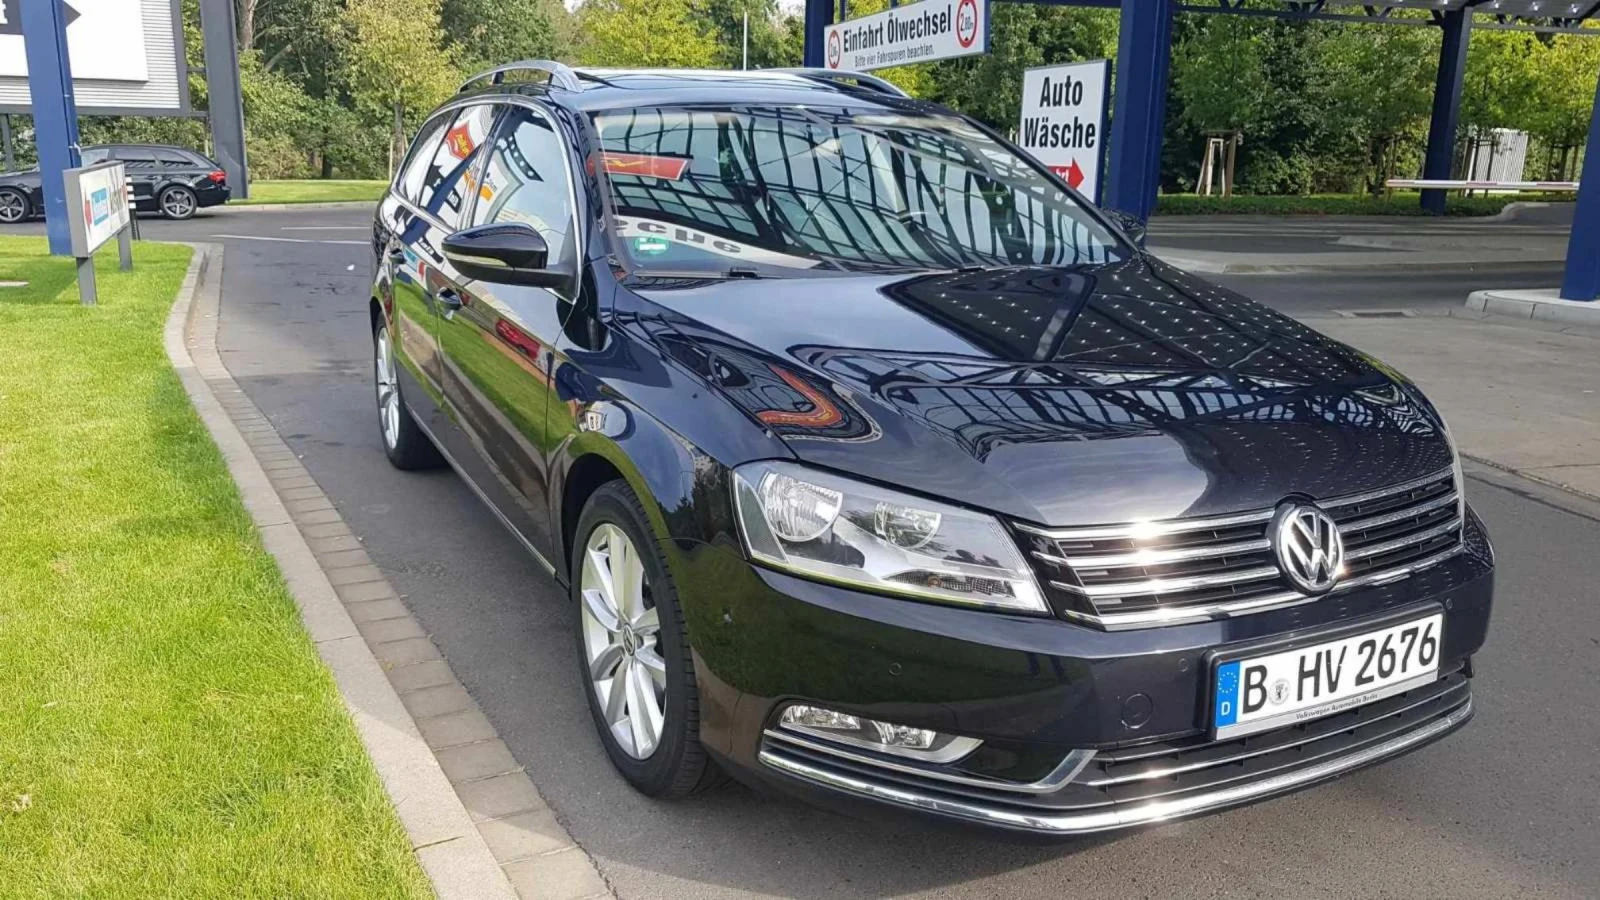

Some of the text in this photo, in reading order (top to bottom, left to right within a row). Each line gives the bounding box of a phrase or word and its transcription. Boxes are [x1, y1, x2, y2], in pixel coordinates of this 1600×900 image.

[843, 3, 952, 53] Einfahrt Ölwechsel
[855, 55, 866, 67] Bitte
[1039, 75, 1083, 108] Auto
[1024, 116, 1096, 148] Wäsche
[1276, 505, 1343, 592] VW
[1242, 622, 1436, 715] B HV 2676
[1220, 701, 1231, 716] D
